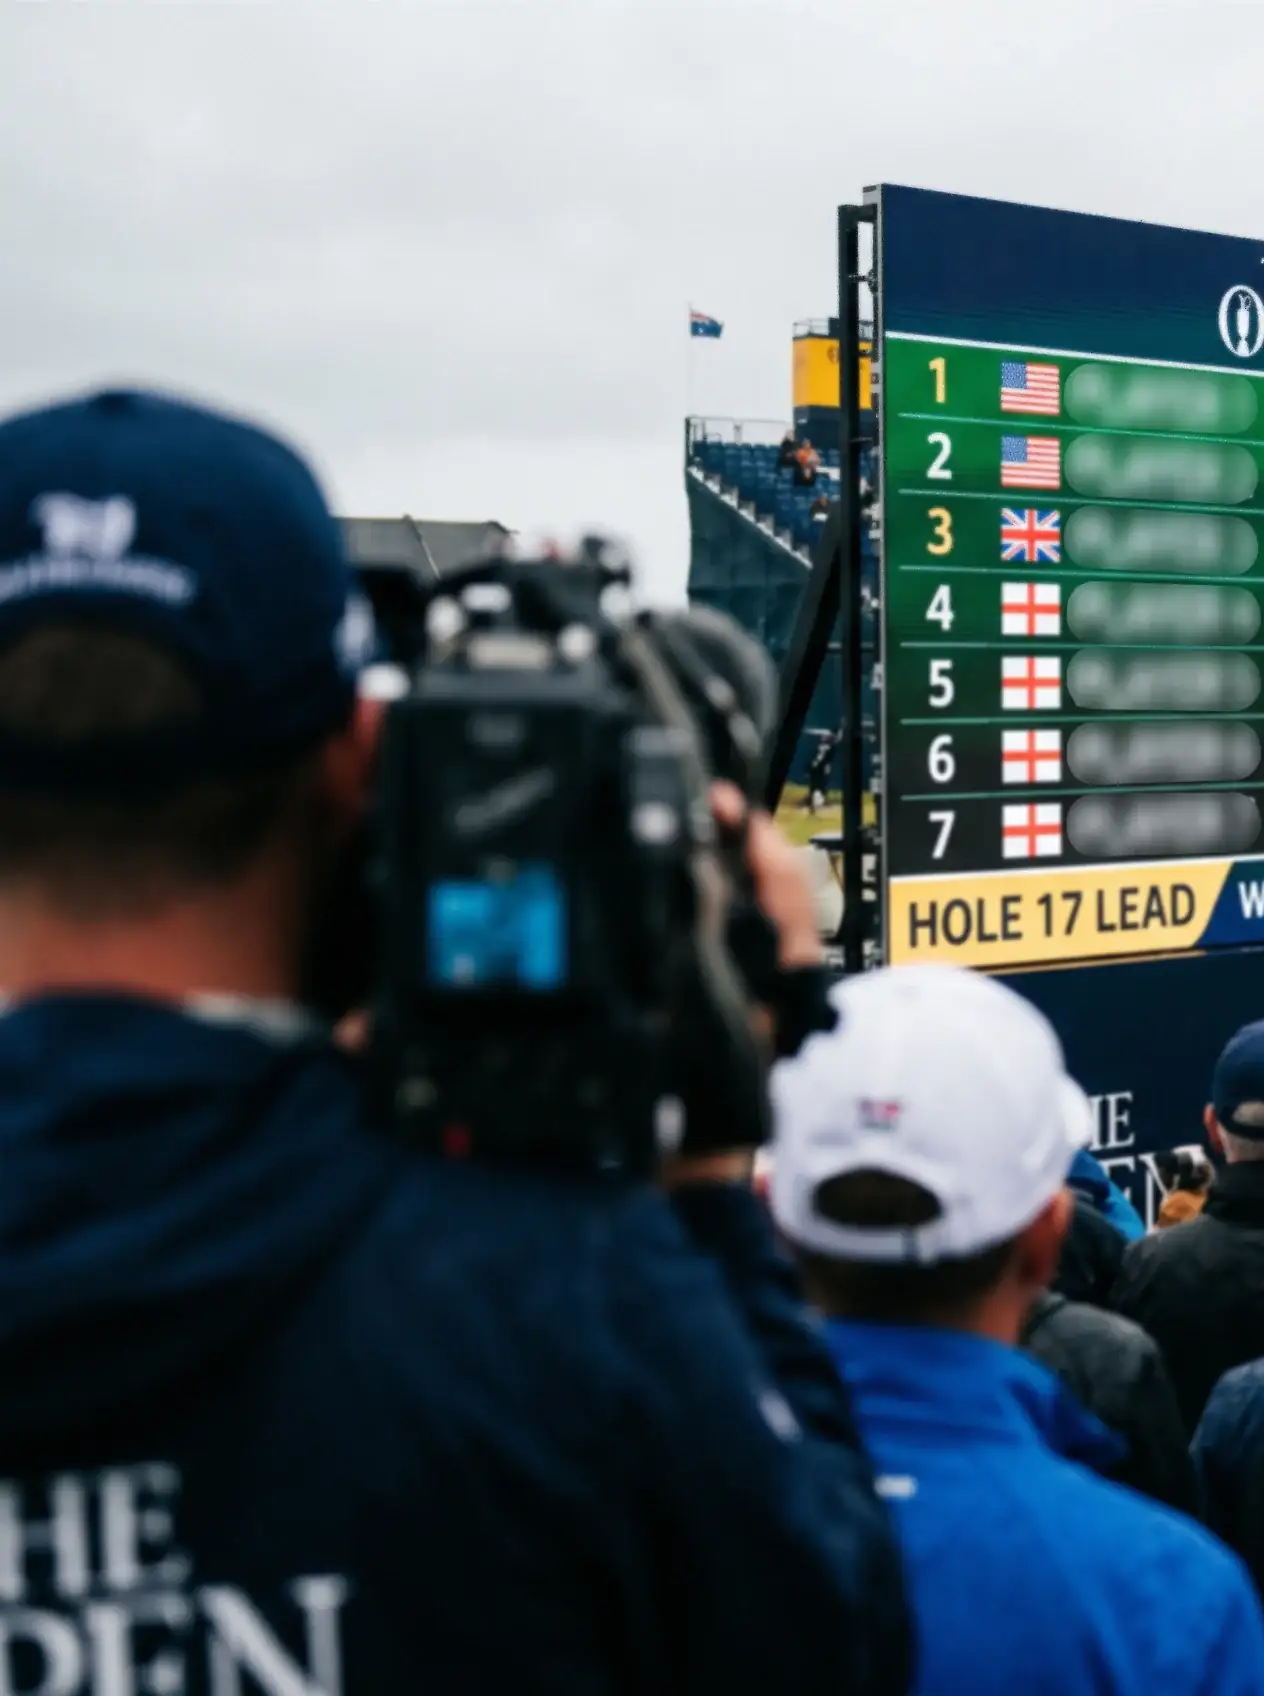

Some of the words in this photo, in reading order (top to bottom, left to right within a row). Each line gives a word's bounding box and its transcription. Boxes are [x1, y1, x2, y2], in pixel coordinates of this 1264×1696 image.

[929, 357, 947, 404] 1
[927, 432, 953, 481] 2
[927, 507, 953, 556] 3
[926, 584, 955, 632] 4
[928, 659, 955, 708] 5
[928, 734, 956, 784] 6
[929, 810, 956, 860] 7
[909, 895, 1023, 949] HOLE
[1037, 890, 1083, 938] 17
[1097, 883, 1196, 933] LEAD
[0, 1460, 190, 1600] HE
